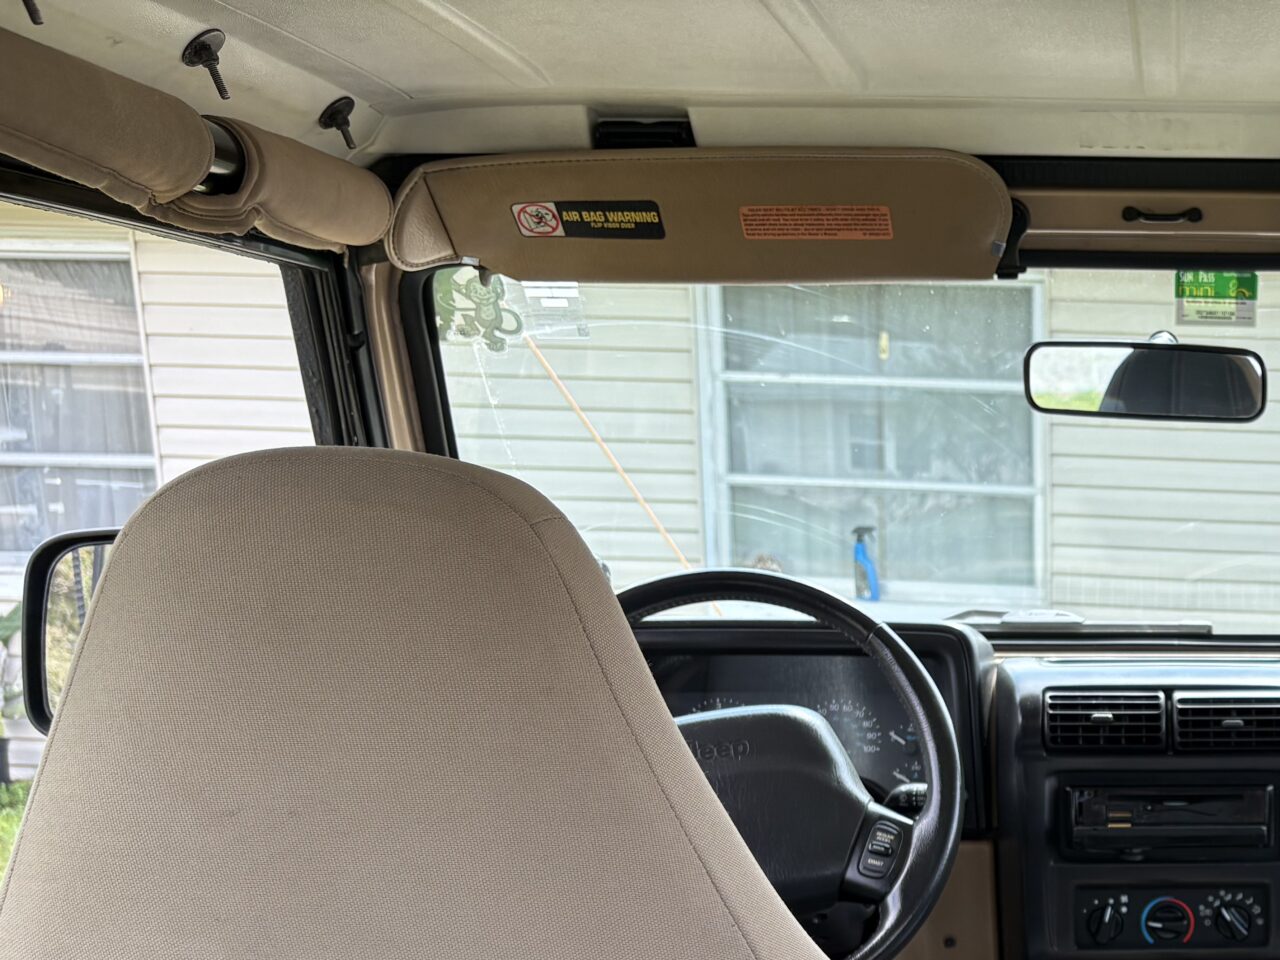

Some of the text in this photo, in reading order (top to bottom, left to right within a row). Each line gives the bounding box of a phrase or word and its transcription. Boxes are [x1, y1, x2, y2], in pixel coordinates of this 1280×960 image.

[562, 211, 659, 223] AIR BAG WARNING
[866, 732, 877, 740] 90
